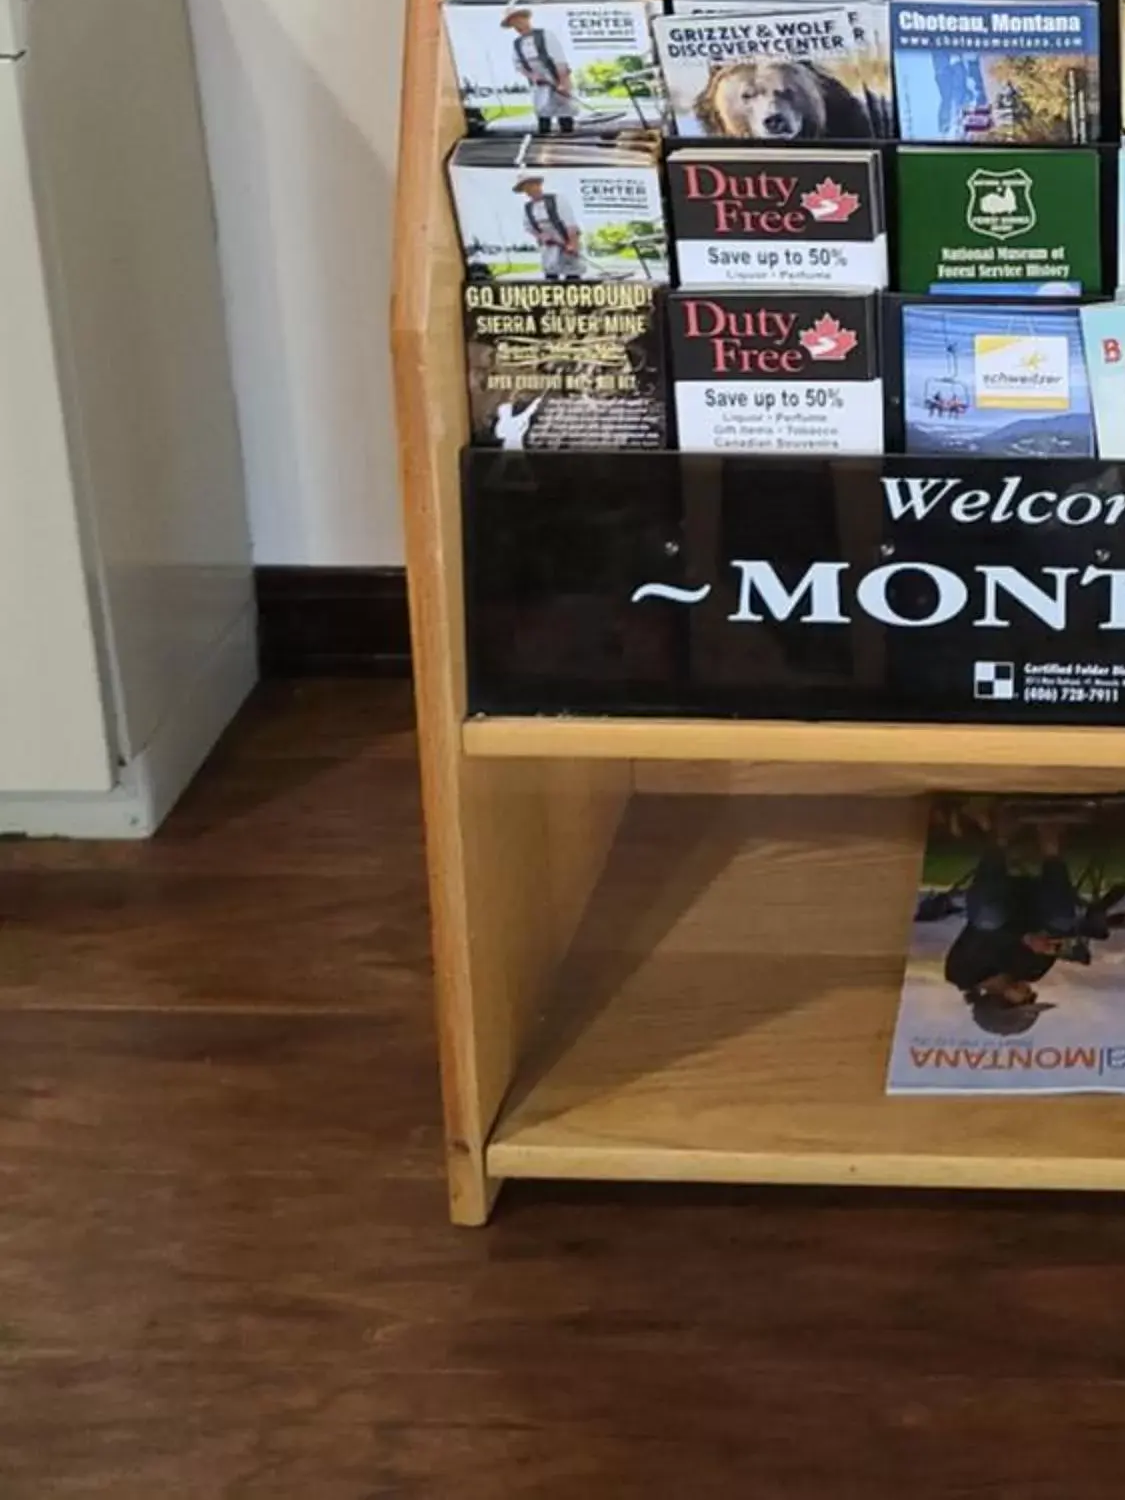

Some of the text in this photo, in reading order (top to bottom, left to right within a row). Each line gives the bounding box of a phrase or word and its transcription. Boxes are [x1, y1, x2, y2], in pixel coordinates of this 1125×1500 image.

[668, 26, 753, 42] GRIZZLY
[756, 24, 773, 38] &
[775, 21, 836, 37] WOLF
[899, 10, 1081, 34] Choteau, Montana
[667, 36, 845, 59] DISCOVERY CENTER
[900, 36, 1083, 49] www.choteaumontana.com
[683, 164, 798, 208] Duty
[713, 200, 807, 234] Free
[708, 247, 848, 270] Save up to 50%
[942, 245, 1065, 260] National Museum of
[937, 263, 1070, 278] Forest Service History
[466, 284, 653, 308] GO UNDERGROUND!
[476, 315, 646, 334] SIERRA SILVER MINE
[683, 302, 798, 345] Duty
[711, 339, 803, 373] Free
[982, 371, 1063, 387] schweitzer
[704, 388, 845, 411] Save up to 50%
[1024, 663, 1072, 674] Certified
[1075, 664, 1110, 675] Folder
